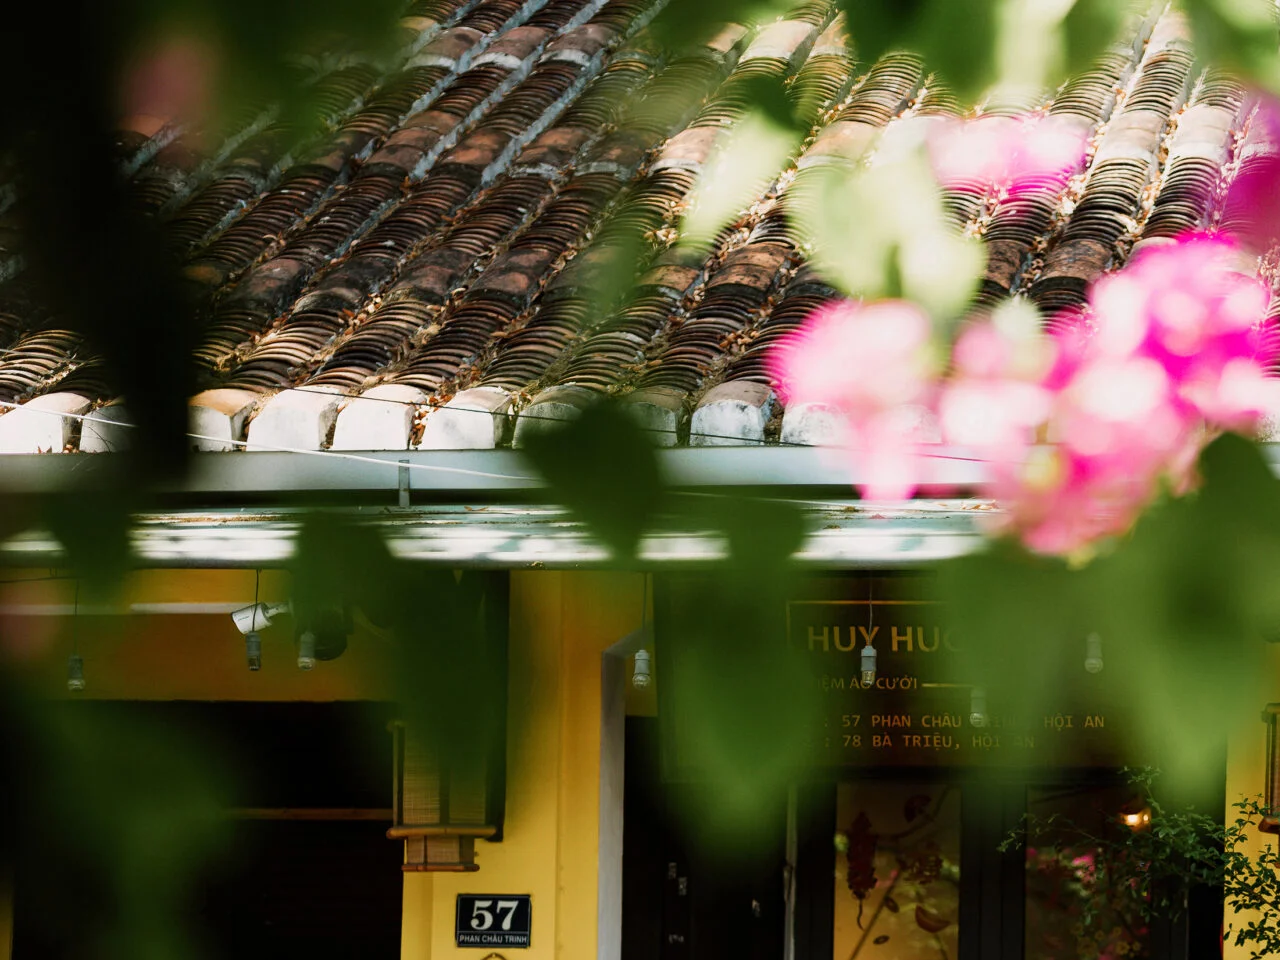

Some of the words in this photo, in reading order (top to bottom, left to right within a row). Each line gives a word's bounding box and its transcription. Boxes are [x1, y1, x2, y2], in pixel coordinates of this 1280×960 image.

[842, 714, 861, 728] 57
[871, 714, 911, 728] PHAN
[921, 712, 962, 728] CHÂU
[1084, 715, 1105, 728] AN
[843, 734, 862, 747] 78
[470, 900, 519, 931] 57
[459, 934, 480, 943] PHAN
[505, 934, 527, 944] TRINH
